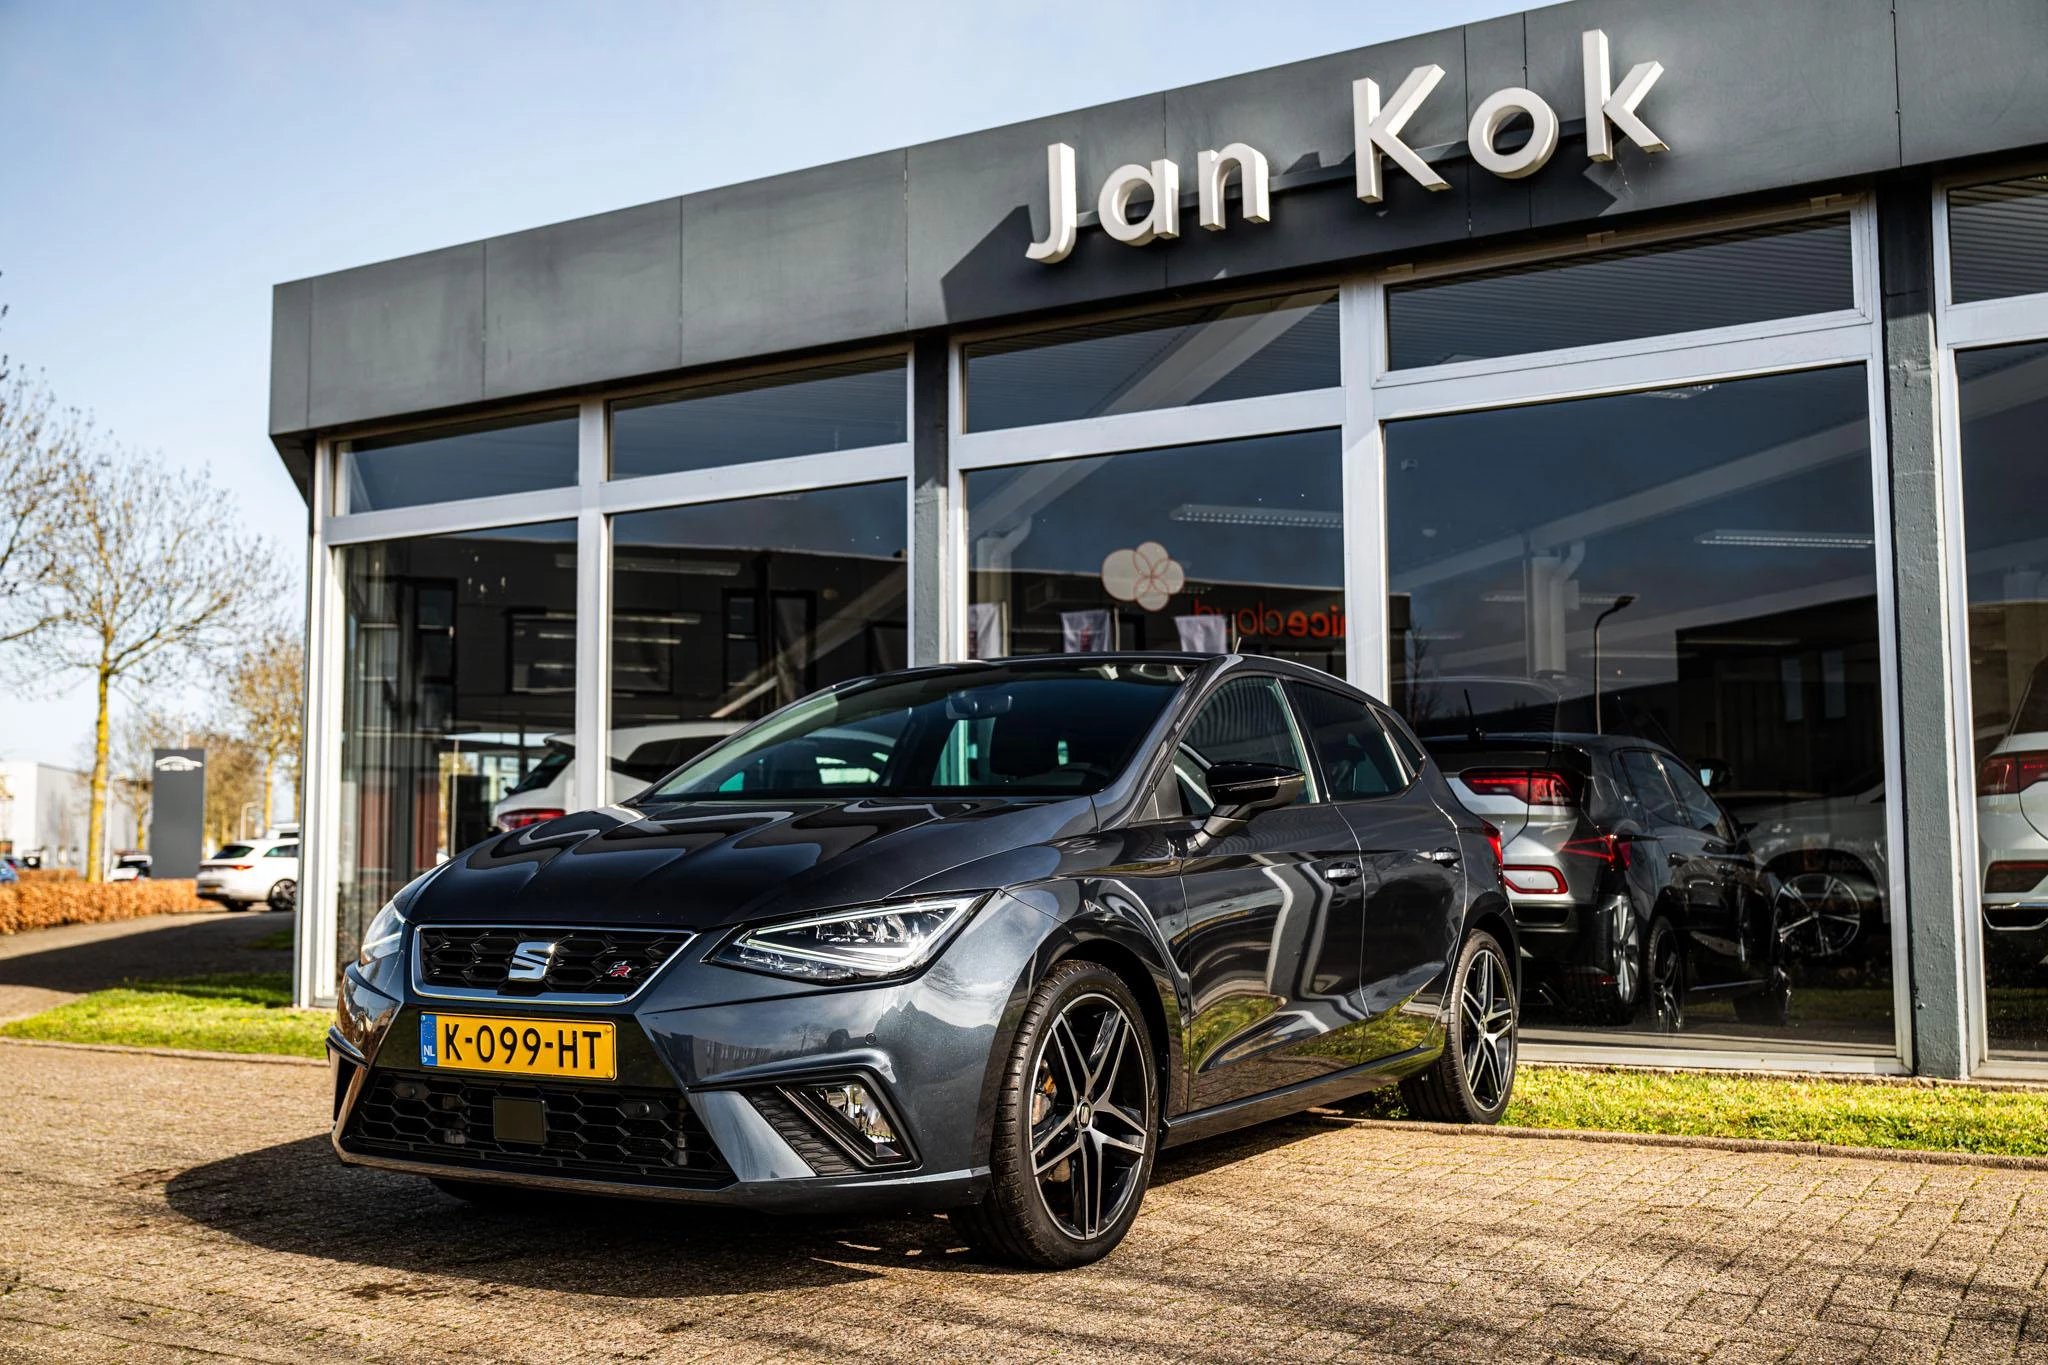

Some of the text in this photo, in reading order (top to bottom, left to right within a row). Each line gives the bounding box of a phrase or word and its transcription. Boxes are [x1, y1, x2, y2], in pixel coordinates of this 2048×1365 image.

[1025, 29, 1670, 264] Jan Kok
[423, 1044, 436, 1057] NL
[445, 1023, 602, 1070] K-099-HT
